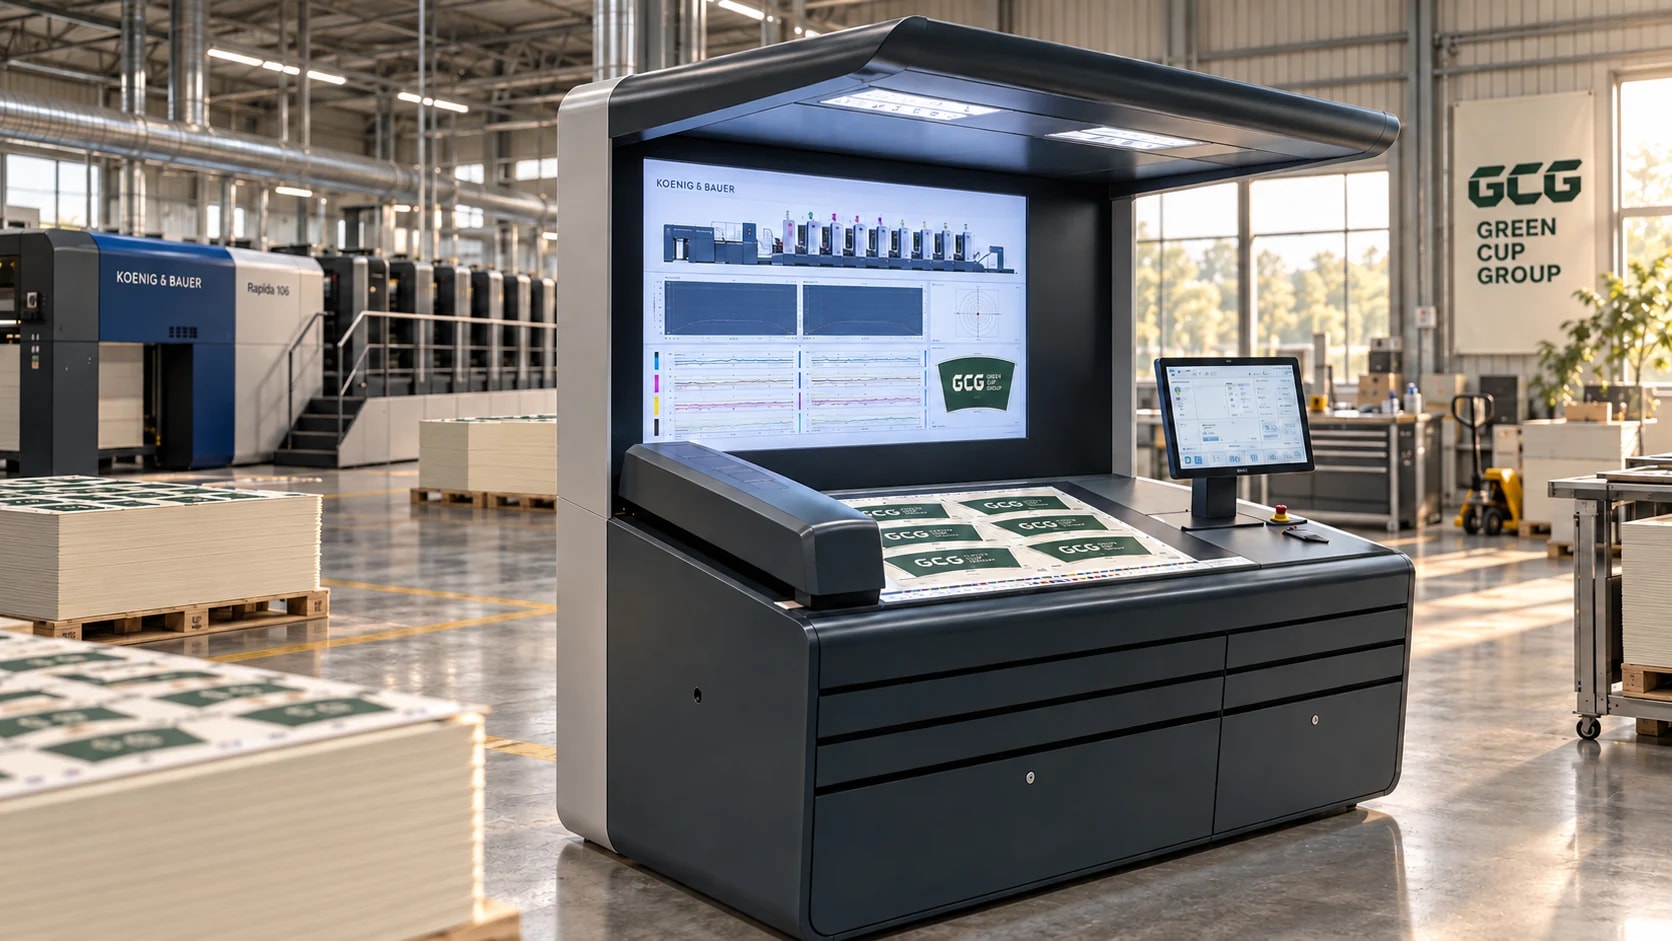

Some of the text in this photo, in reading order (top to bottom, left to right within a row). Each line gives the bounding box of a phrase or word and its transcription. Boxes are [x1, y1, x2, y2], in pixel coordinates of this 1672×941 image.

[656, 178, 735, 193] KOENIG & BAUER
[1468, 159, 1583, 208] GCG
[1477, 217, 1556, 239] GREEN
[1477, 242, 1525, 262] CUP
[116, 271, 202, 289] KOENIG & BAUER
[1477, 264, 1561, 285] GROUP
[247, 282, 290, 296] Rapida 106
[952, 374, 985, 392] GCG
[984, 500, 1023, 509] GCG
[1018, 521, 1058, 530] GCG
[884, 530, 929, 540] GCG
[1058, 543, 1101, 554] GCG
[914, 555, 964, 567] GCG
